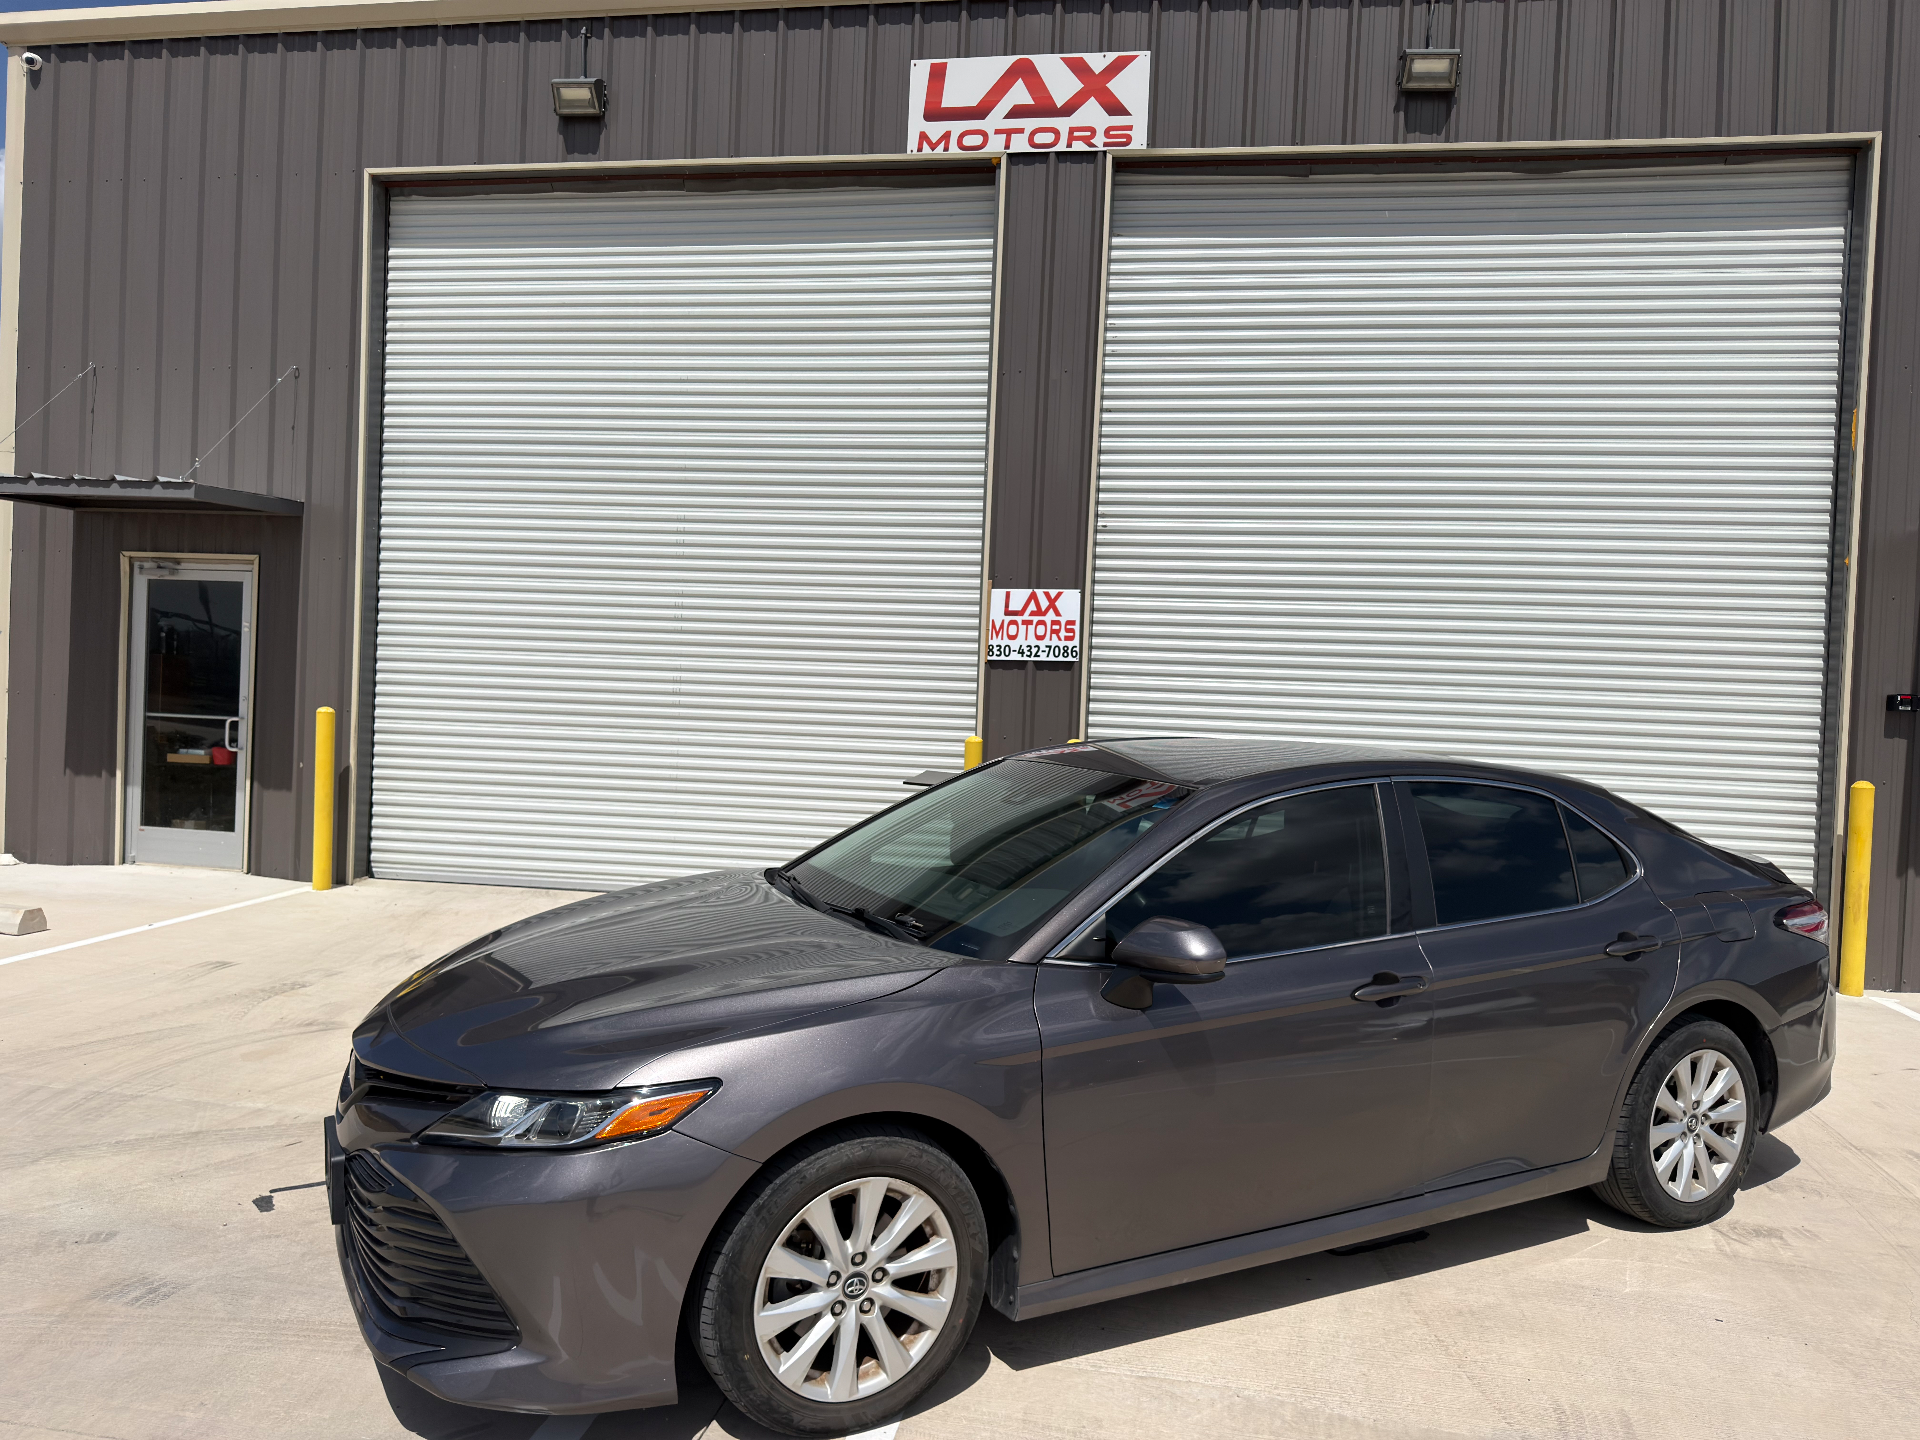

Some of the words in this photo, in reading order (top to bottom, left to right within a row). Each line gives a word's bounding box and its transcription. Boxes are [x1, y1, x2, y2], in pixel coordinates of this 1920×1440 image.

[923, 54, 1140, 122] LAX
[916, 124, 1134, 153] MOTORS
[1003, 590, 1065, 618] LAX
[990, 618, 1077, 642] MOTORS
[987, 643, 1079, 659] 830-432-7086
